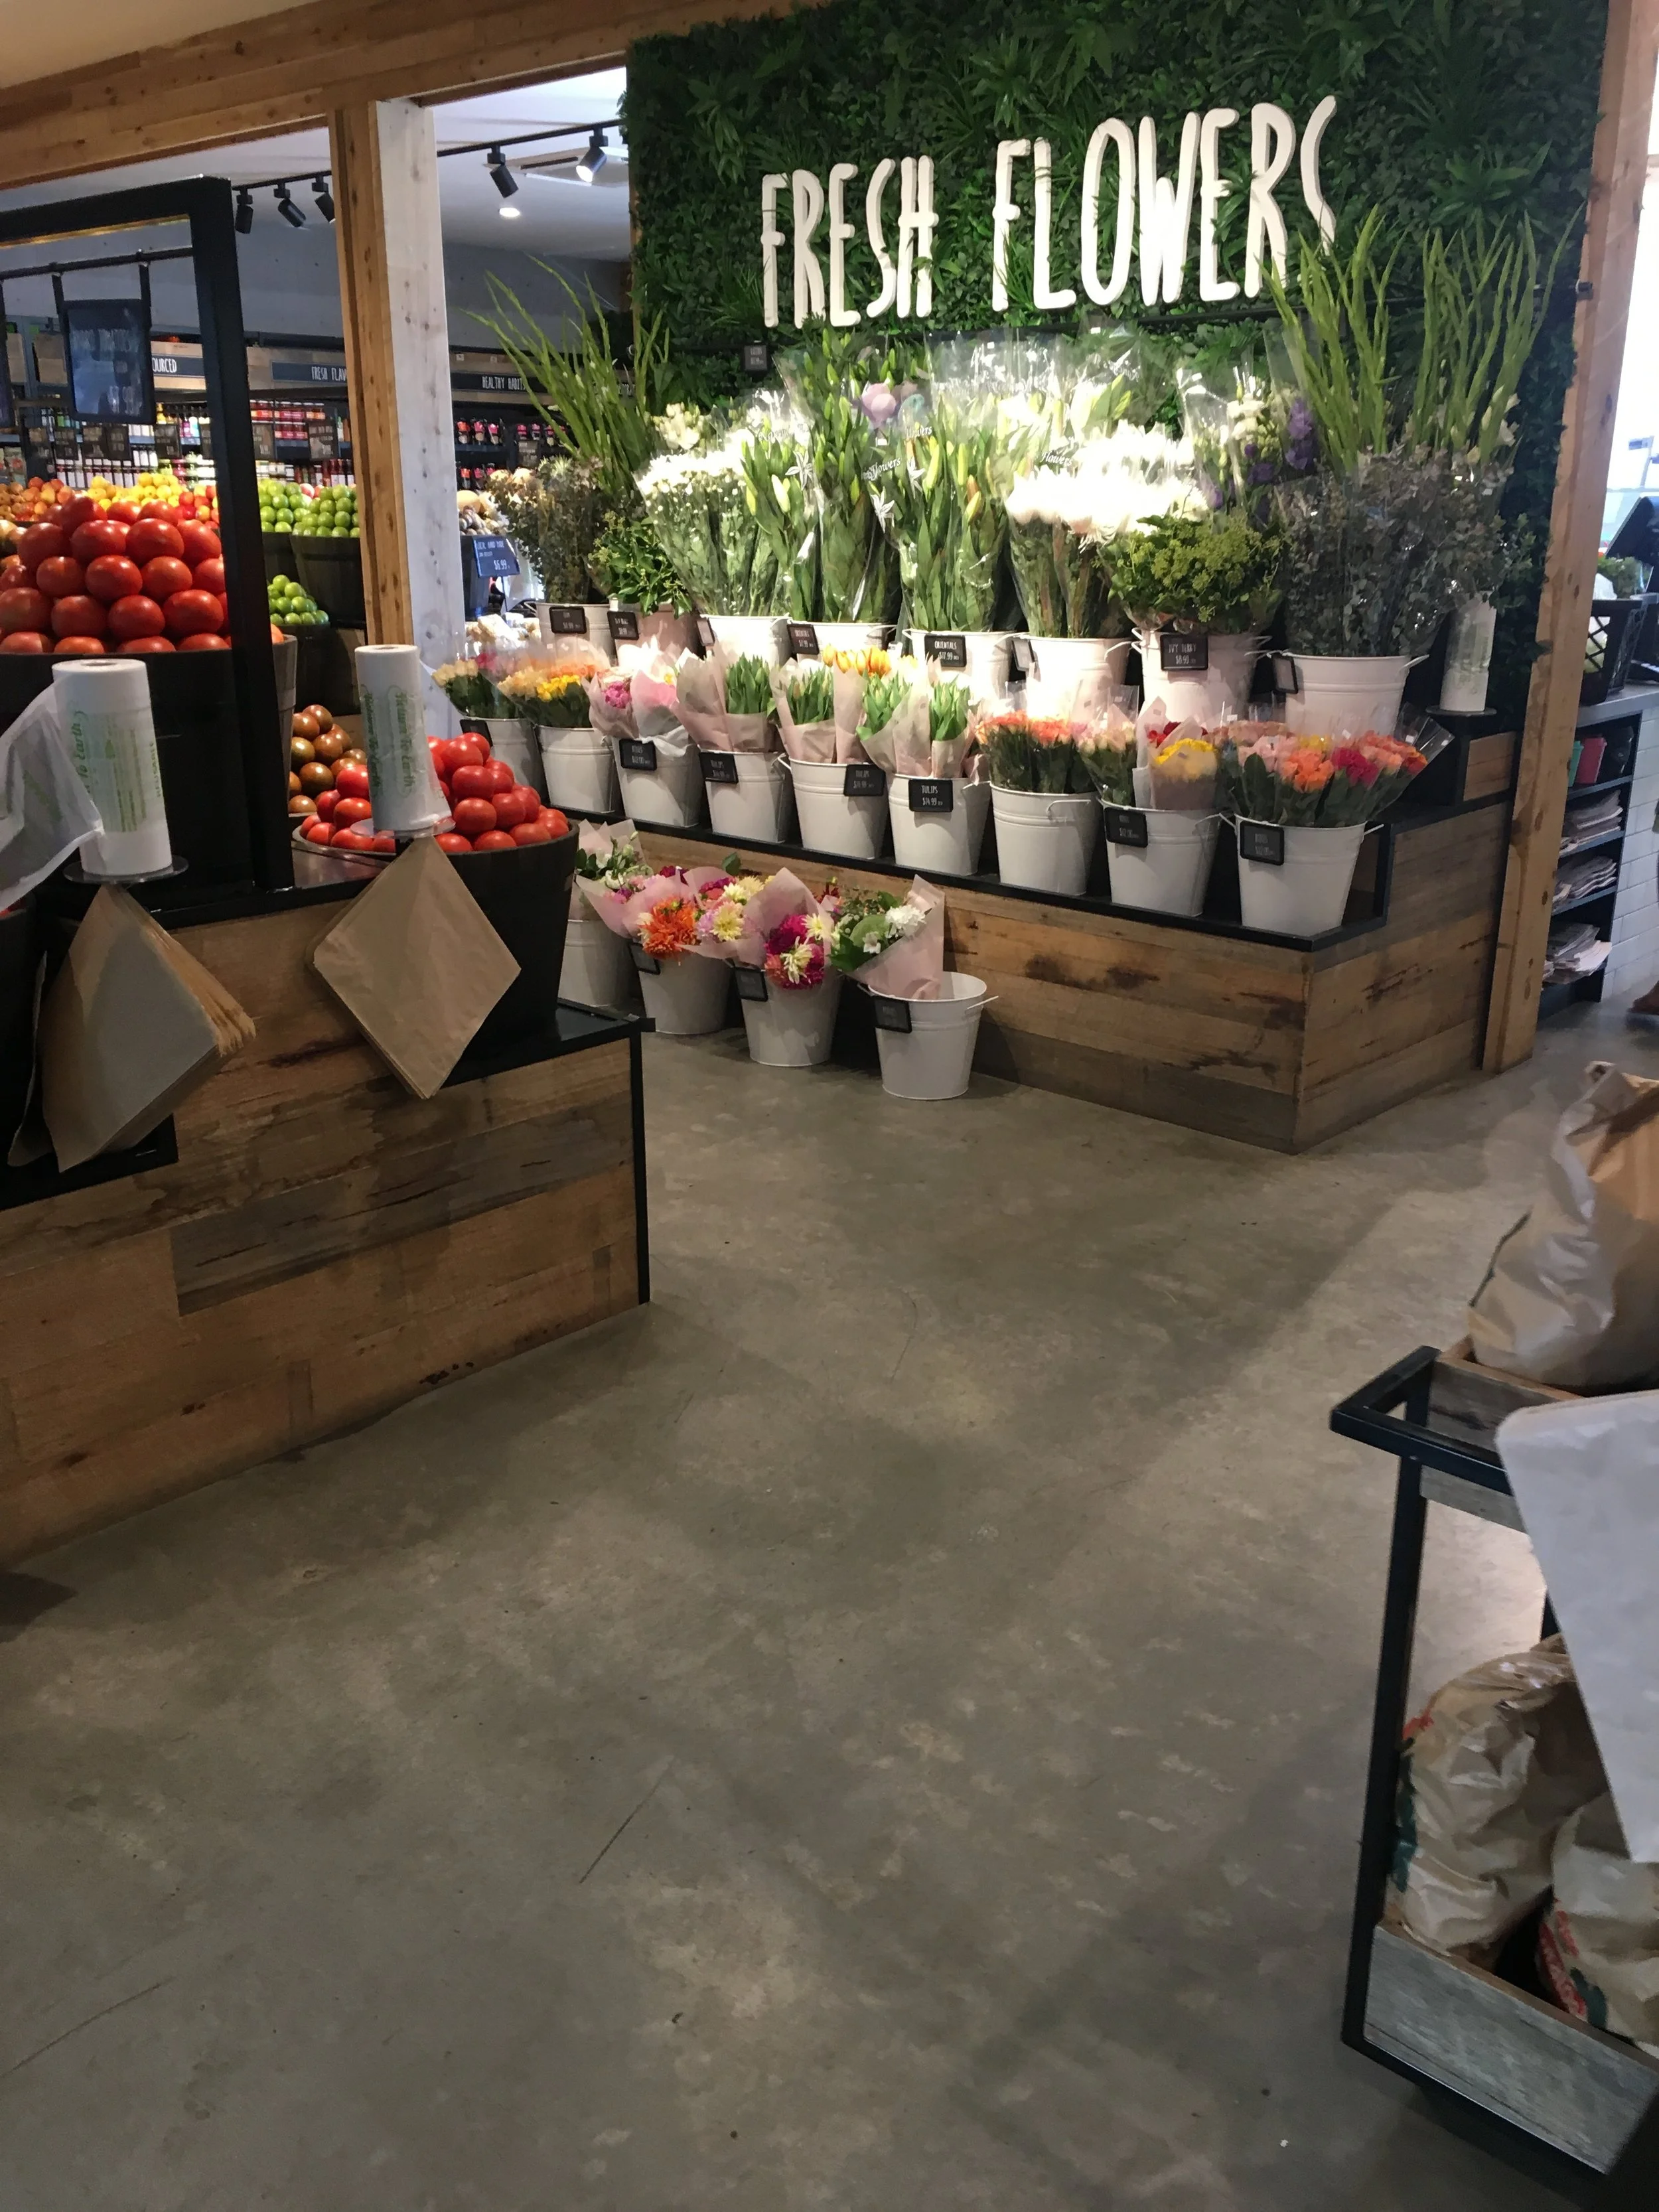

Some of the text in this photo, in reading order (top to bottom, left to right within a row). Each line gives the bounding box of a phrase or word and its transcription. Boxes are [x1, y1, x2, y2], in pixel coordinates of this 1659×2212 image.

[760, 95, 1337, 329] FRESH FLOWERS
[151, 357, 177, 374] OURCED
[311, 366, 328, 380] FRESH
[482, 376, 505, 390] HEALTHY
[934, 640, 957, 650] ORIENTALS
[920, 784, 938, 794] TULIPS
